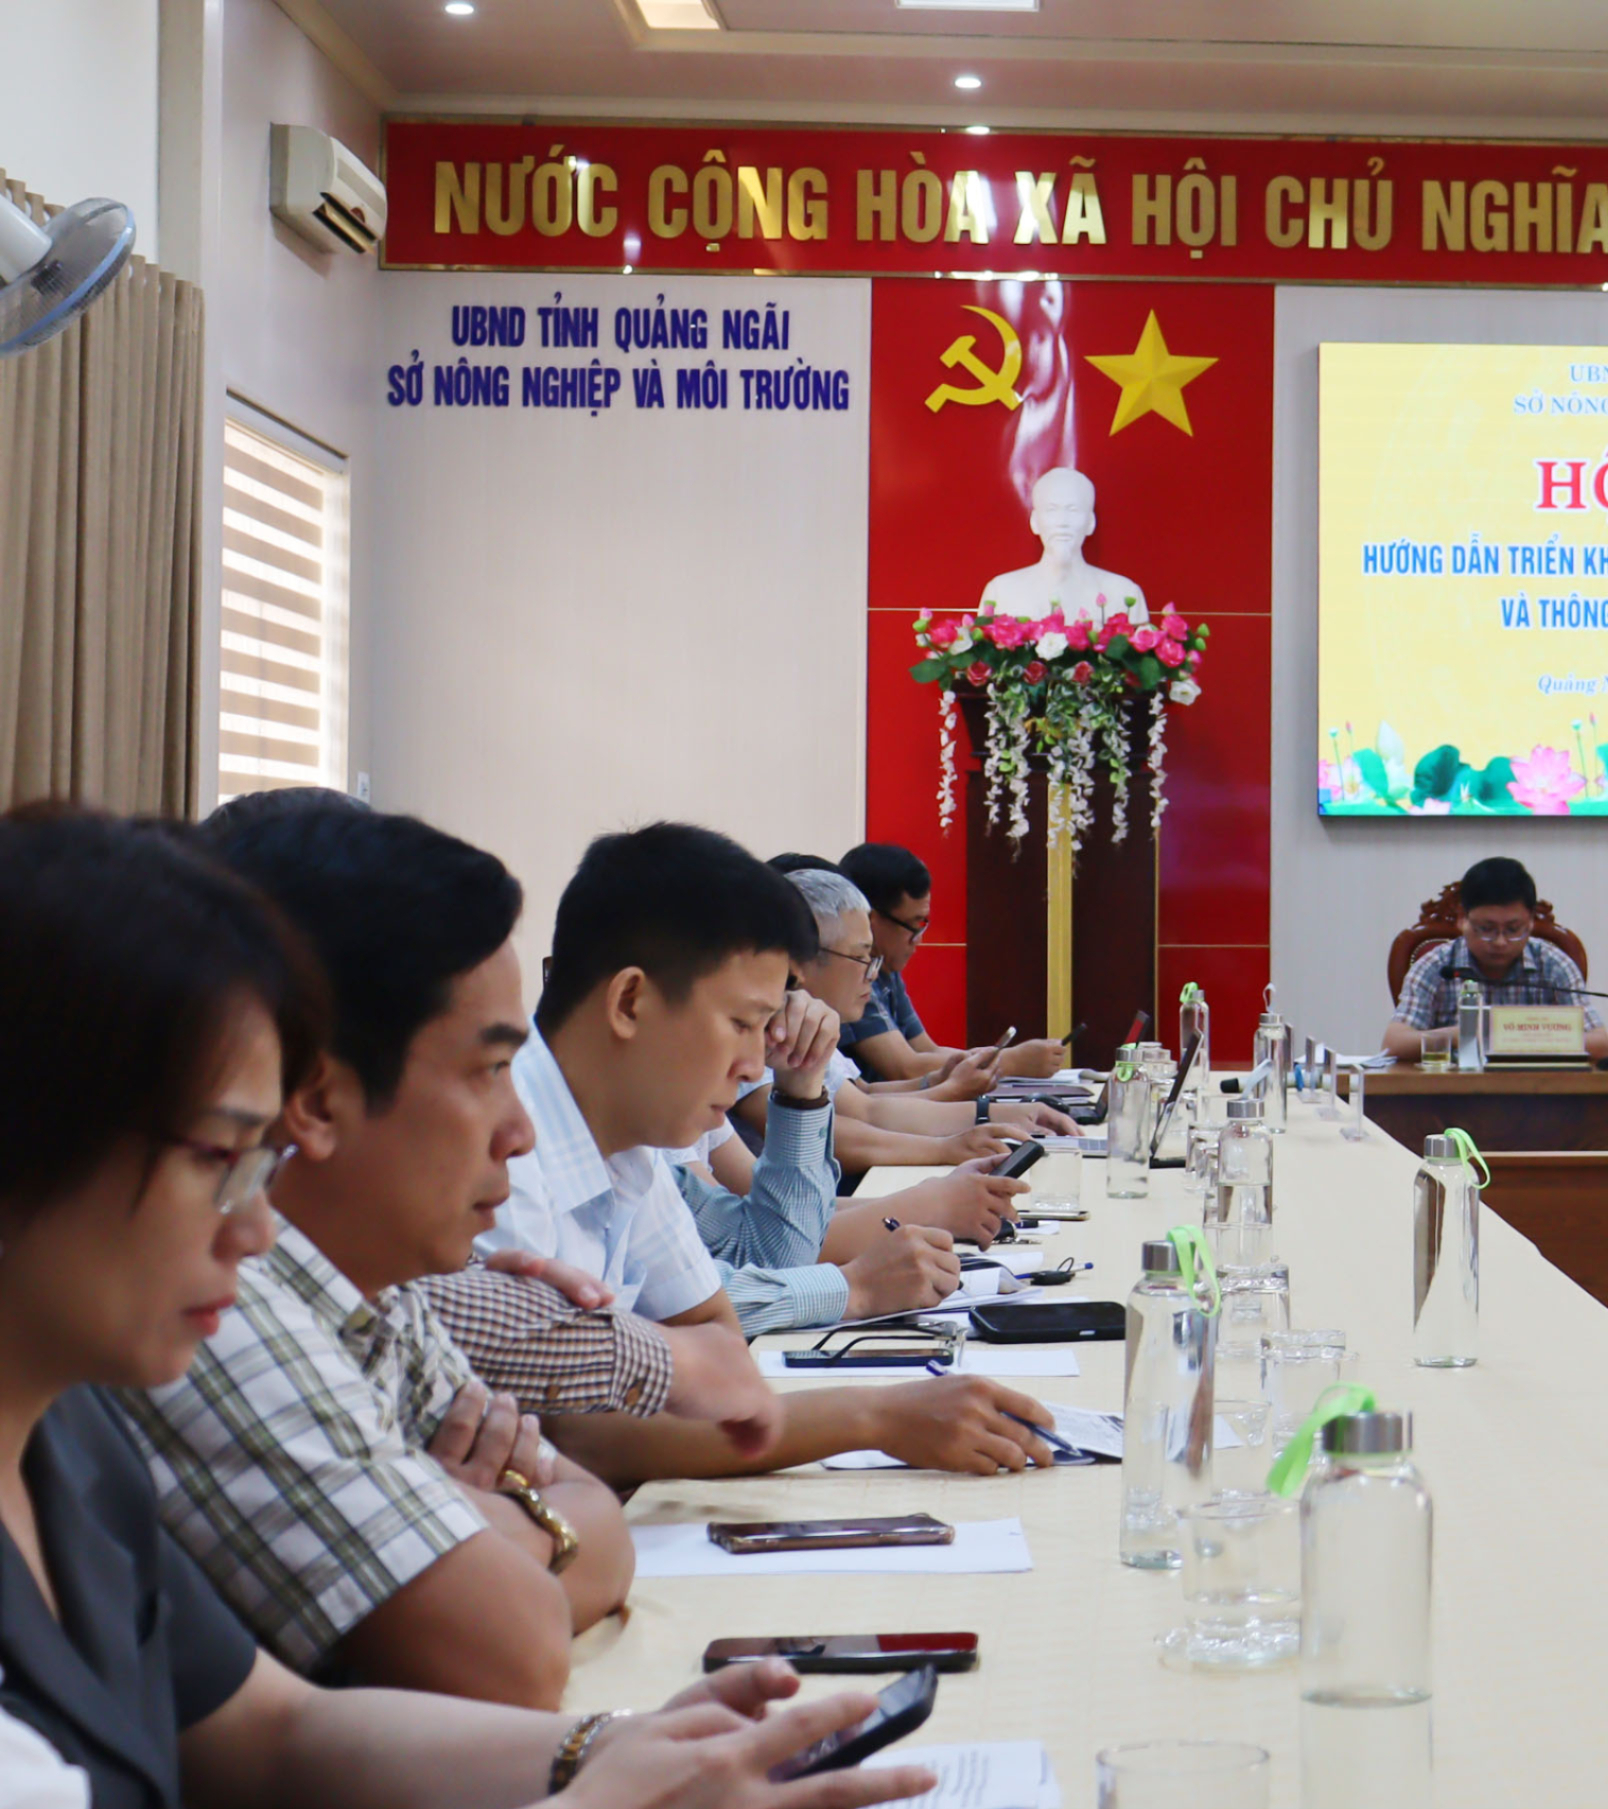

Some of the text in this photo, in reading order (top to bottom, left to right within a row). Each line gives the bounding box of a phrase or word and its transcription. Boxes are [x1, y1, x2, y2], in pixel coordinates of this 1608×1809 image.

[434, 144, 618, 237] NƯỚC
[648, 149, 829, 253] CỘNG
[856, 151, 990, 245] HÒA
[1013, 155, 1107, 246] XÃ
[1130, 156, 1238, 259] HỘI
[1264, 157, 1393, 252] CHỦ
[451, 291, 790, 353] UBND TỈNH QUẢNG NGÃI
[387, 349, 850, 418] SỞ NÔNG NGHIỆP VÀ MÔI TRƯỜNG
[1513, 390, 1545, 414] SỞ
[1362, 538, 1444, 574] HƯỚNG
[1451, 532, 1500, 574] DẪN
[1508, 533, 1575, 575] TRIỂN
[1500, 592, 1531, 628] VÀ
[1537, 673, 1597, 694] Quảng
